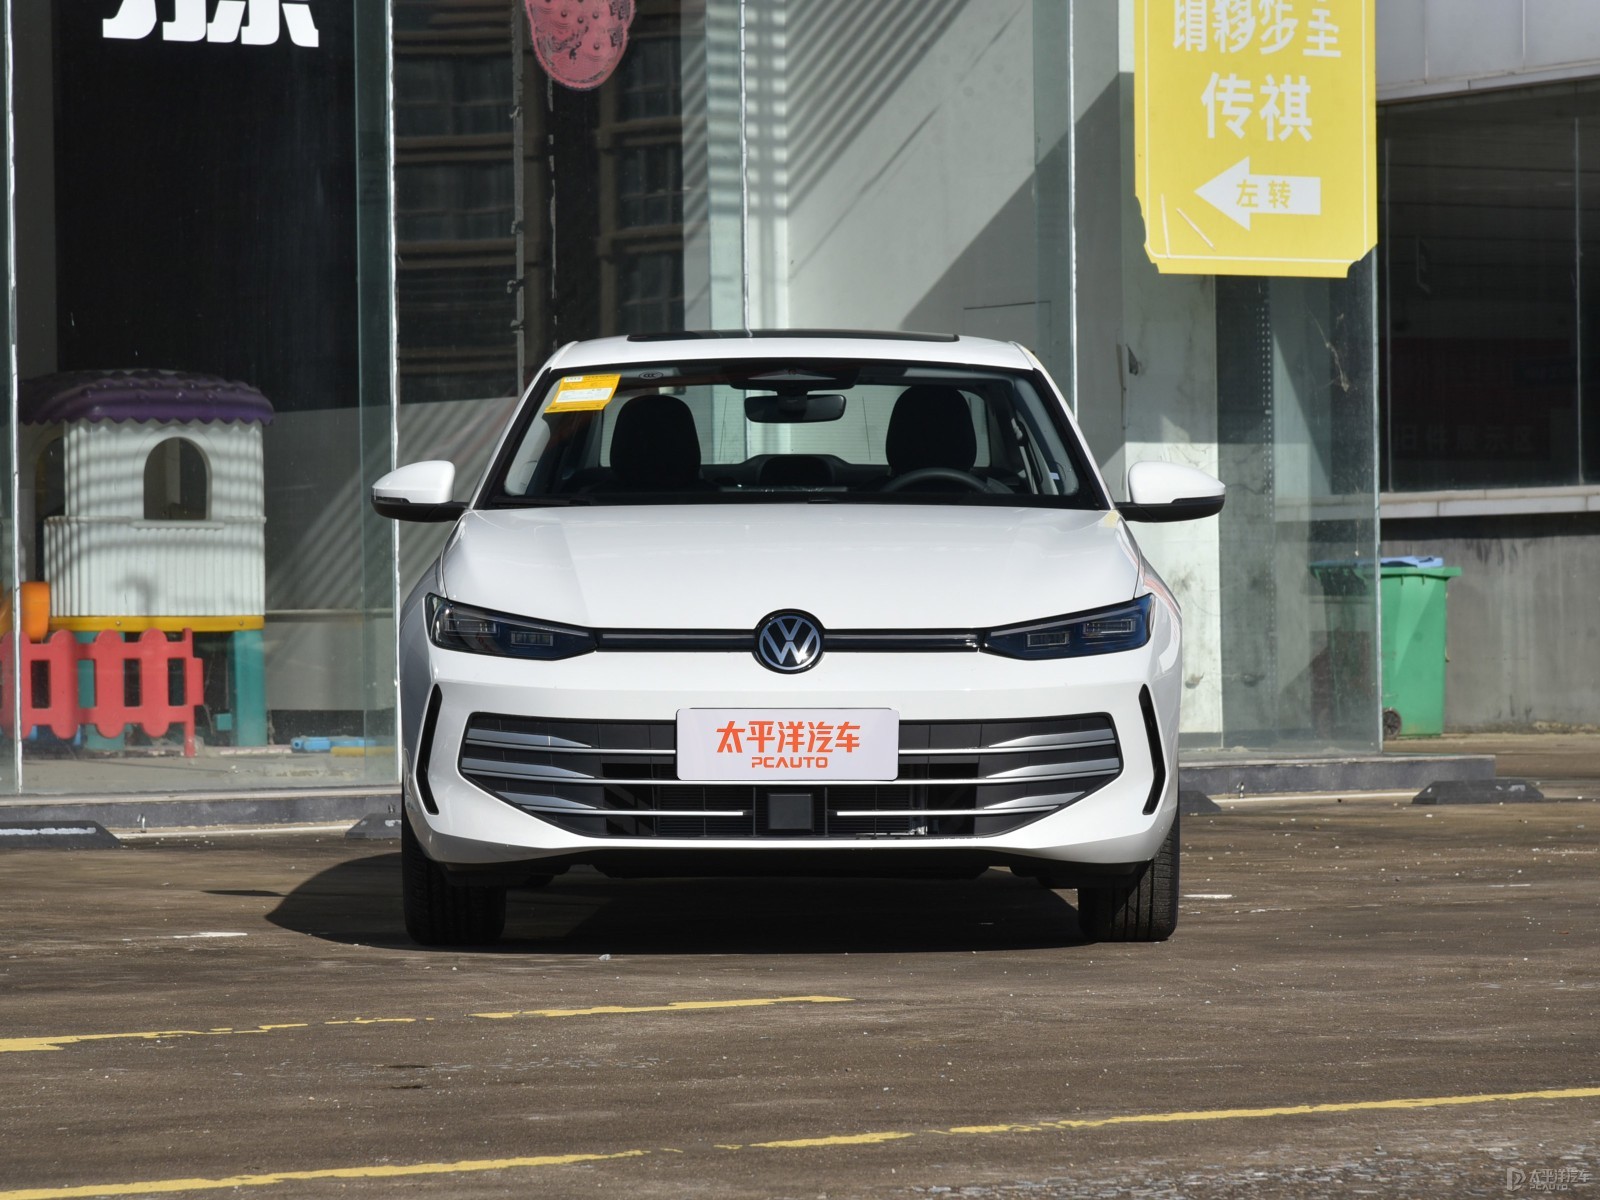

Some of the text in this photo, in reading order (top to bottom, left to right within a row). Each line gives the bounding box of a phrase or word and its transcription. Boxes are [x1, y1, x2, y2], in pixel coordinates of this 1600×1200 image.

[1200, 71, 1313, 143] 传祺
[1235, 179, 1292, 209] 左转
[716, 720, 861, 753] 太平洋汽车
[751, 756, 828, 769] PCAUTO
